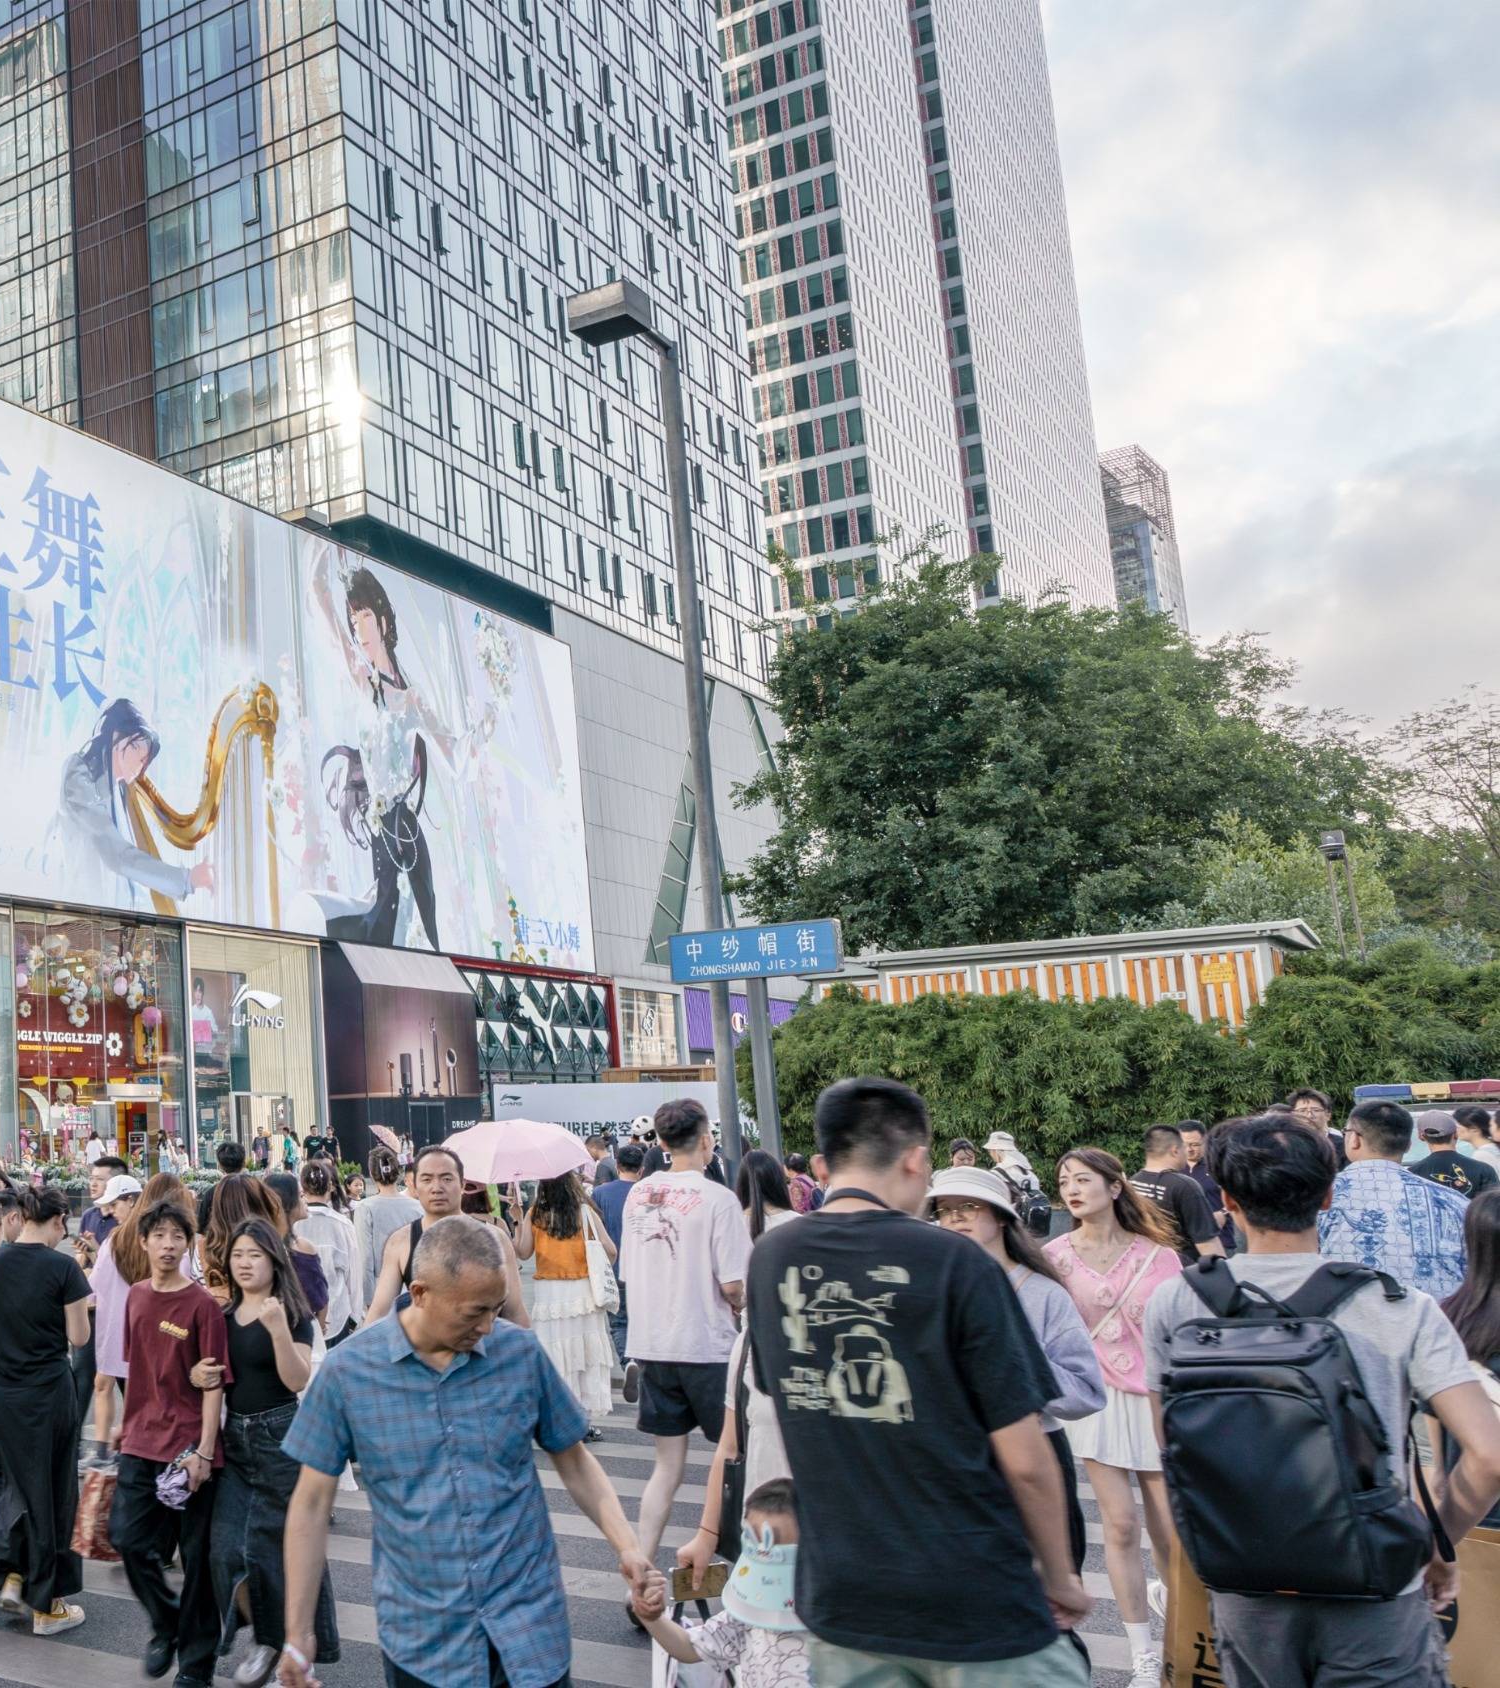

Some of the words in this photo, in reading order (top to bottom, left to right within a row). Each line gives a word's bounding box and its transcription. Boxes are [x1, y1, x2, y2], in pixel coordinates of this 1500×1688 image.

[686, 928, 817, 963] 中纱帽街
[690, 960, 760, 977] ZHONGSHAMAO
[767, 958, 786, 971] JIE
[231, 1013, 285, 1029] LI-NING
